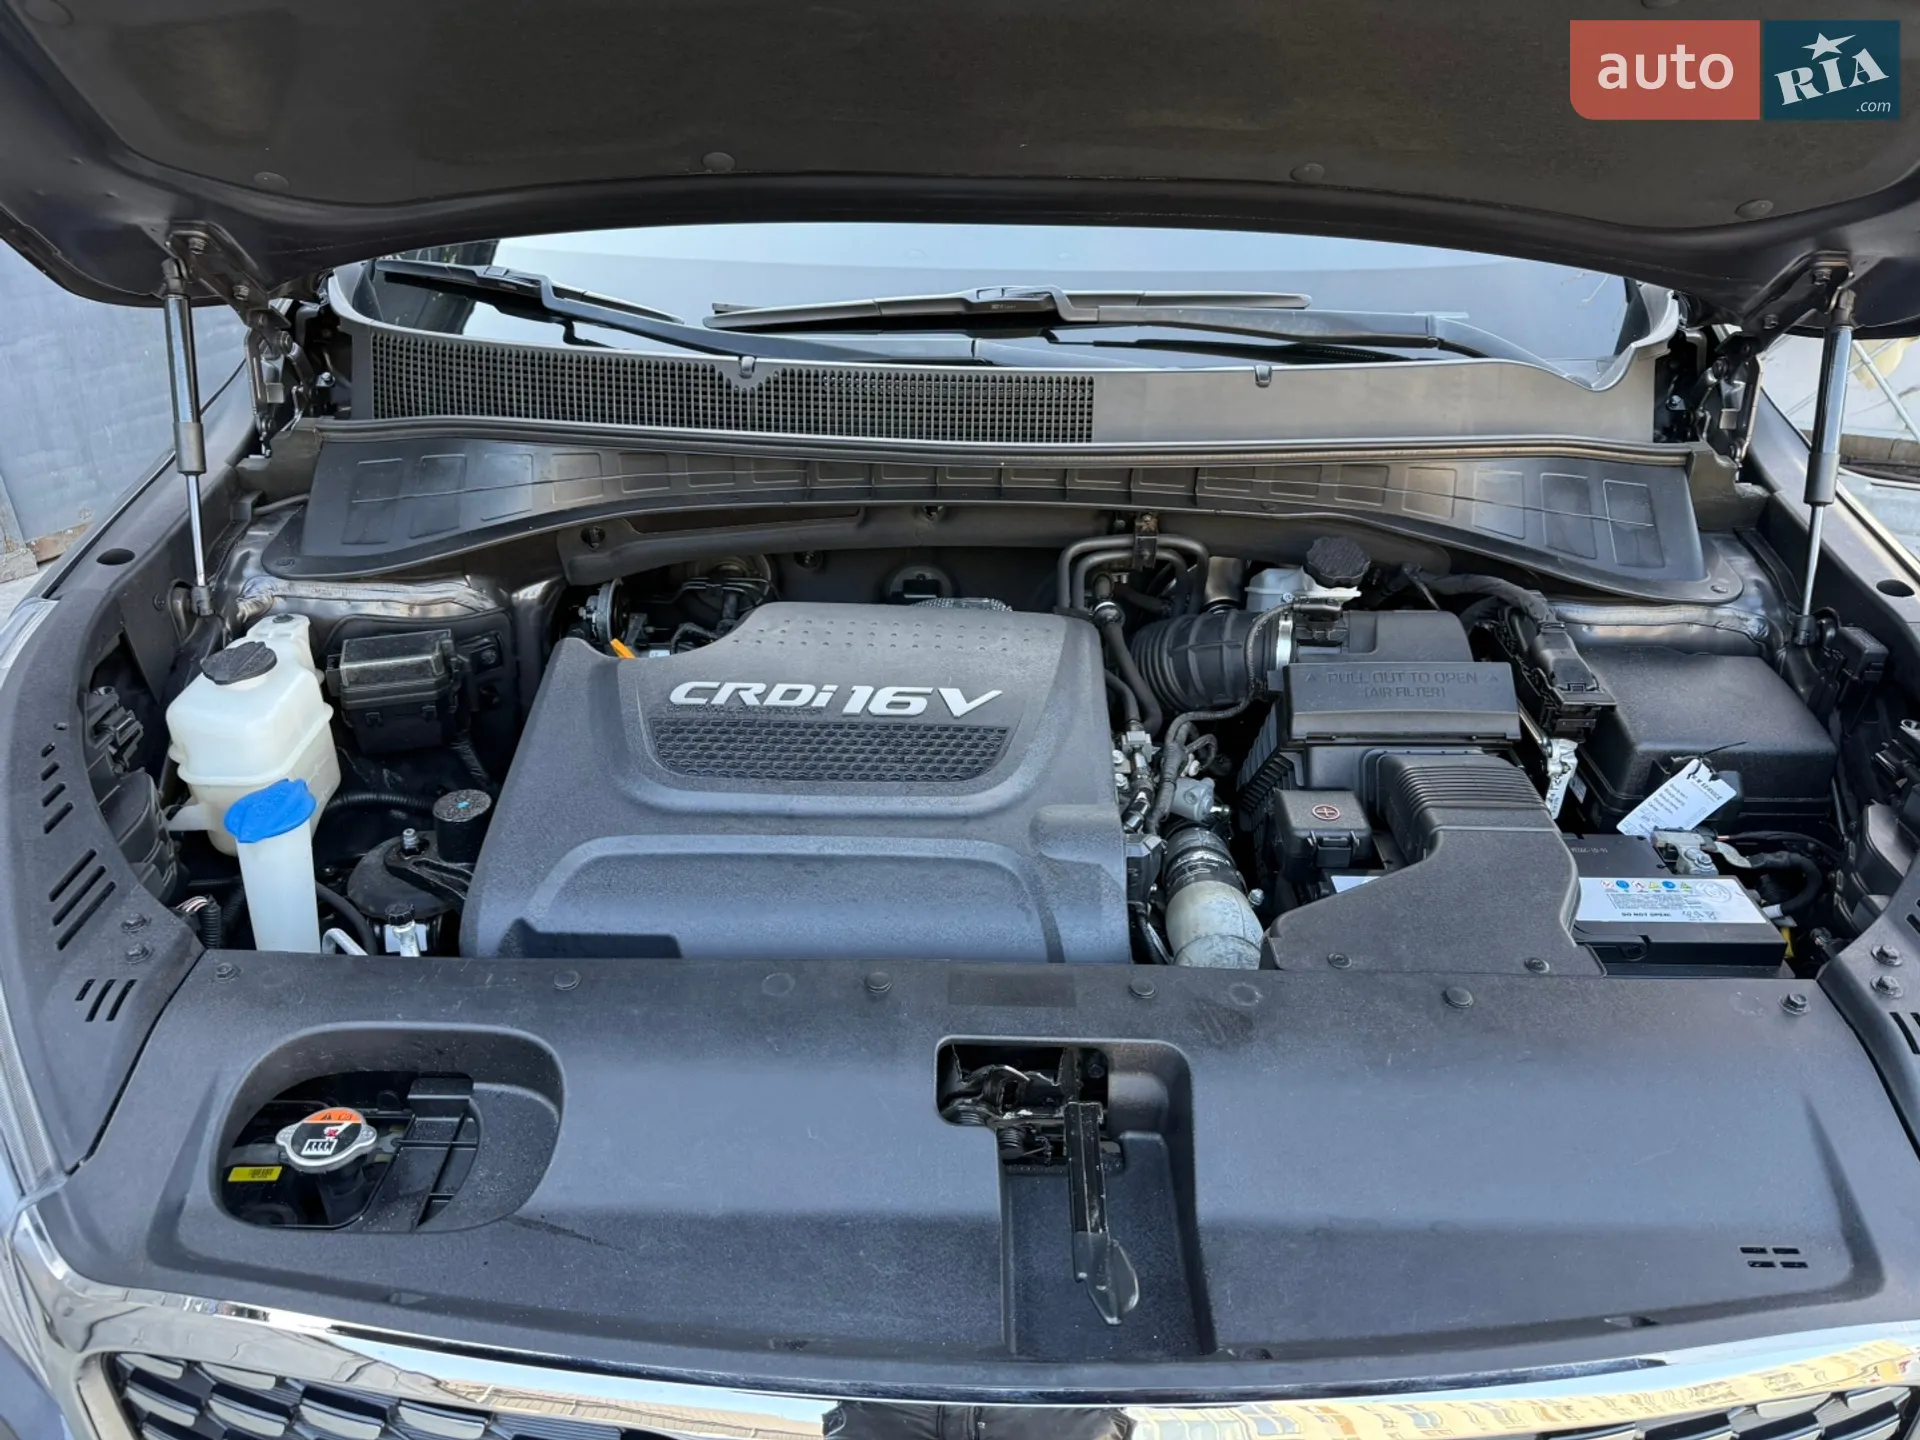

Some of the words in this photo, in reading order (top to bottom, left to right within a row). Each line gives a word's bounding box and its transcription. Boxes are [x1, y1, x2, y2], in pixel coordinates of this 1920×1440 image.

[1326, 672, 1369, 684] PULL
[1373, 671, 1405, 684] OUT
[1409, 671, 1430, 684] TO
[1434, 672, 1478, 685] OPEN
[670, 681, 839, 707] CRDi
[842, 685, 1003, 718] 16V
